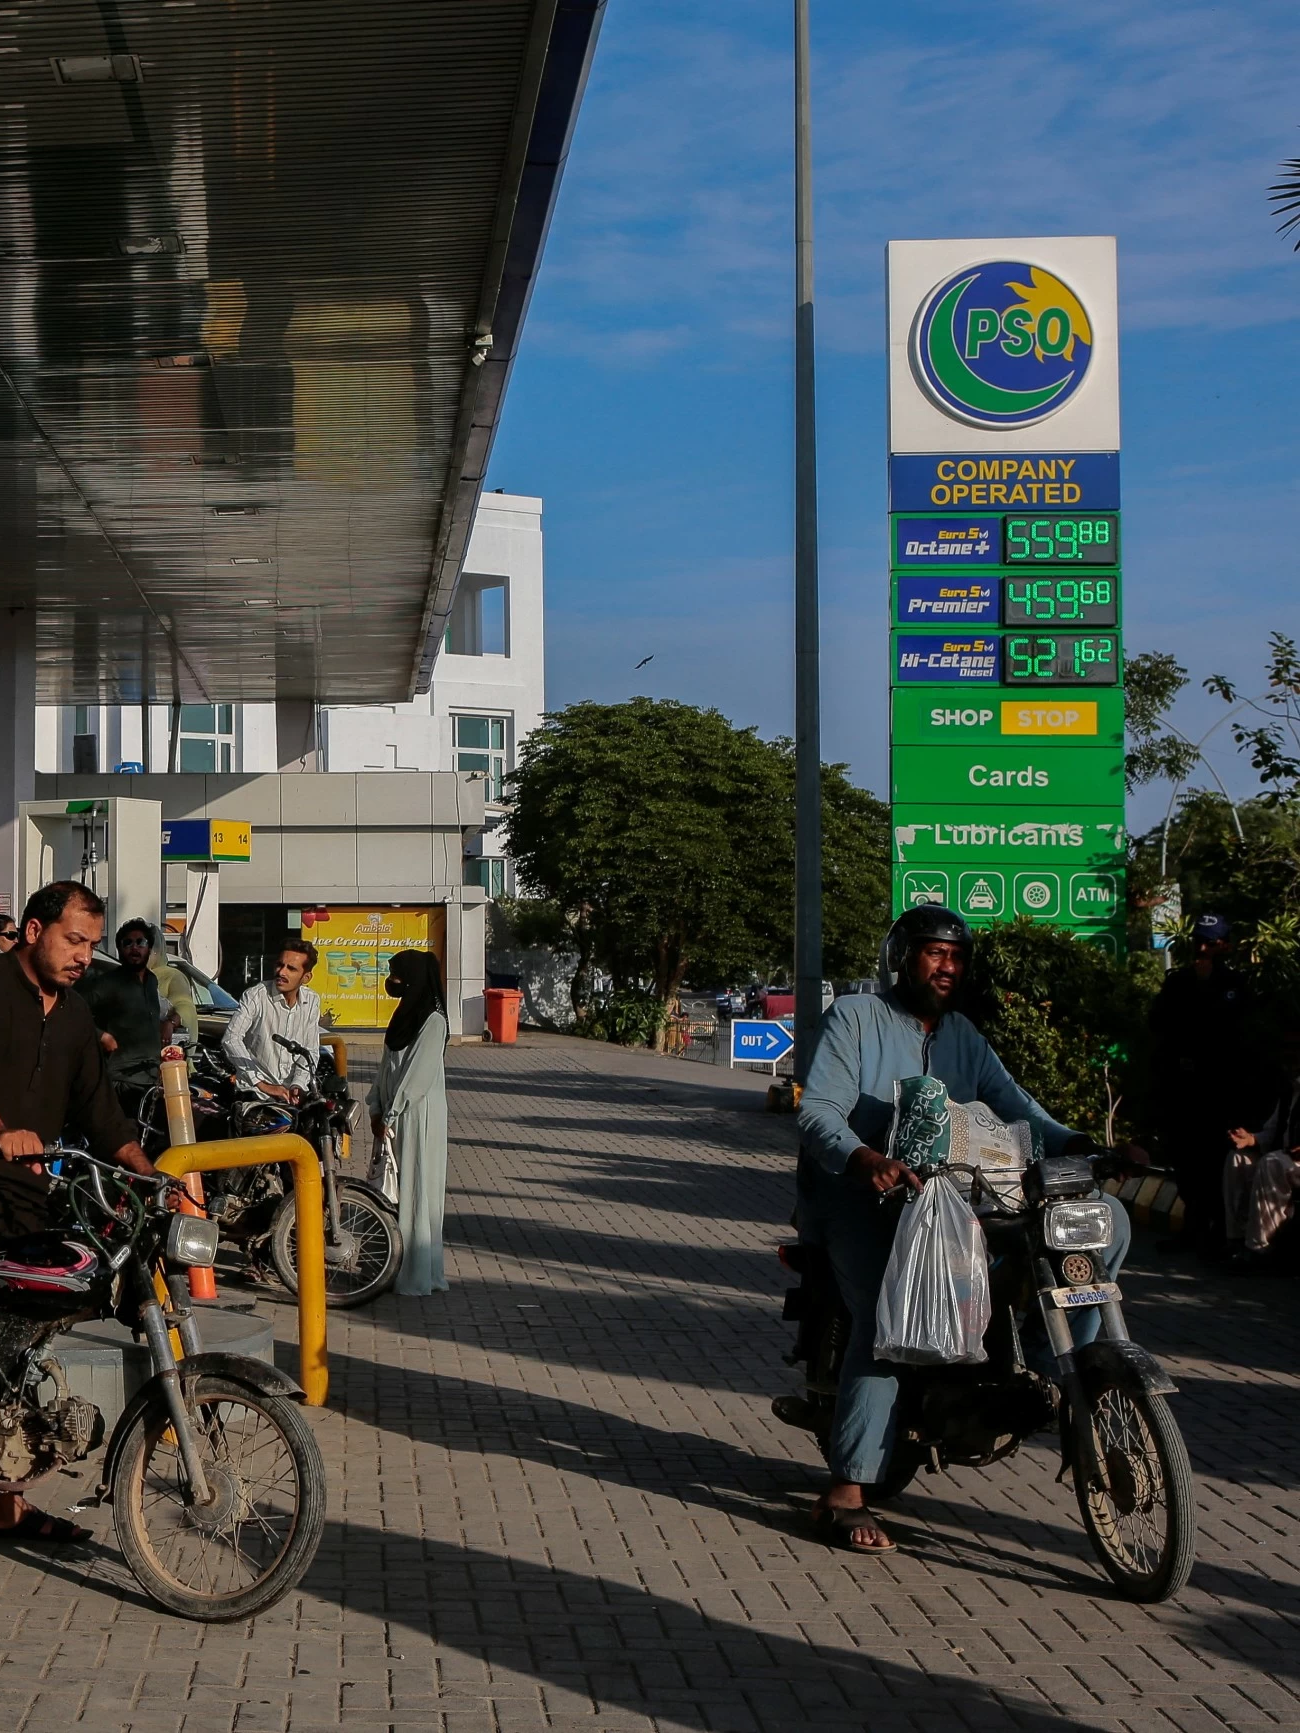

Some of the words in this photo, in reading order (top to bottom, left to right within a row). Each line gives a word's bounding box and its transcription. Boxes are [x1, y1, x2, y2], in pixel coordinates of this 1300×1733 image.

[964, 306, 1072, 359] PSO
[936, 459, 1076, 481] COMPANY
[930, 483, 1081, 505] OPERATED
[938, 530, 966, 540] Euro
[1007, 520, 1110, 559] 559.88
[939, 588, 967, 598] Euro
[1008, 580, 1111, 619] 459.68
[907, 598, 990, 613] Premier
[943, 642, 970, 652] Euro
[900, 653, 996, 668] Hi-Cetane
[959, 668, 994, 677] Diesel
[930, 708, 993, 726] SHOP
[1018, 709, 1080, 727] STOP
[968, 764, 1049, 787] Cards
[213, 832, 223, 843] 13
[238, 834, 248, 844] 14
[935, 823, 1084, 847] Lubricants
[1076, 887, 1110, 902] ATM
[354, 923, 391, 934] Ambala
[312, 937, 333, 946] Ice
[335, 937, 377, 946] Cream
[380, 937, 434, 947] Buckets
[741, 1035, 763, 1047] OUT
